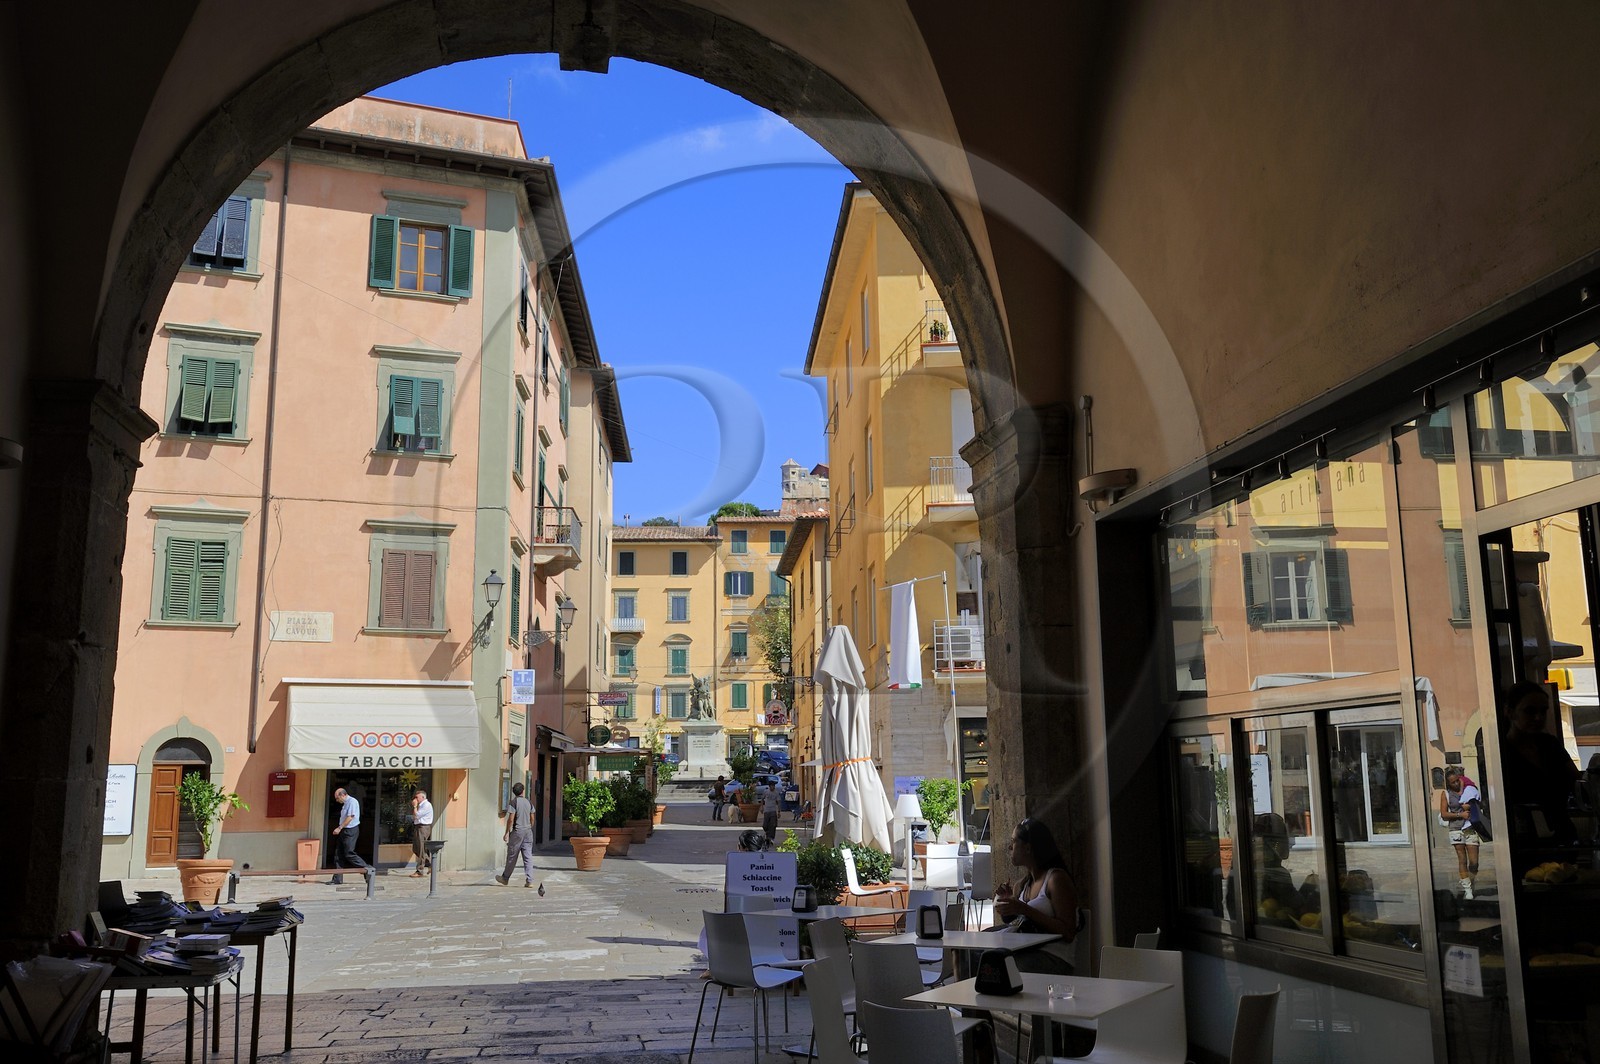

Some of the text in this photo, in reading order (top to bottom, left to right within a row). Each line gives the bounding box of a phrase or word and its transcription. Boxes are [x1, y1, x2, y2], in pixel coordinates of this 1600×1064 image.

[287, 617, 318, 625] PIAZZA
[286, 628, 318, 636] CAVOUR
[517, 671, 529, 683] T
[339, 756, 432, 767] TABACCHI
